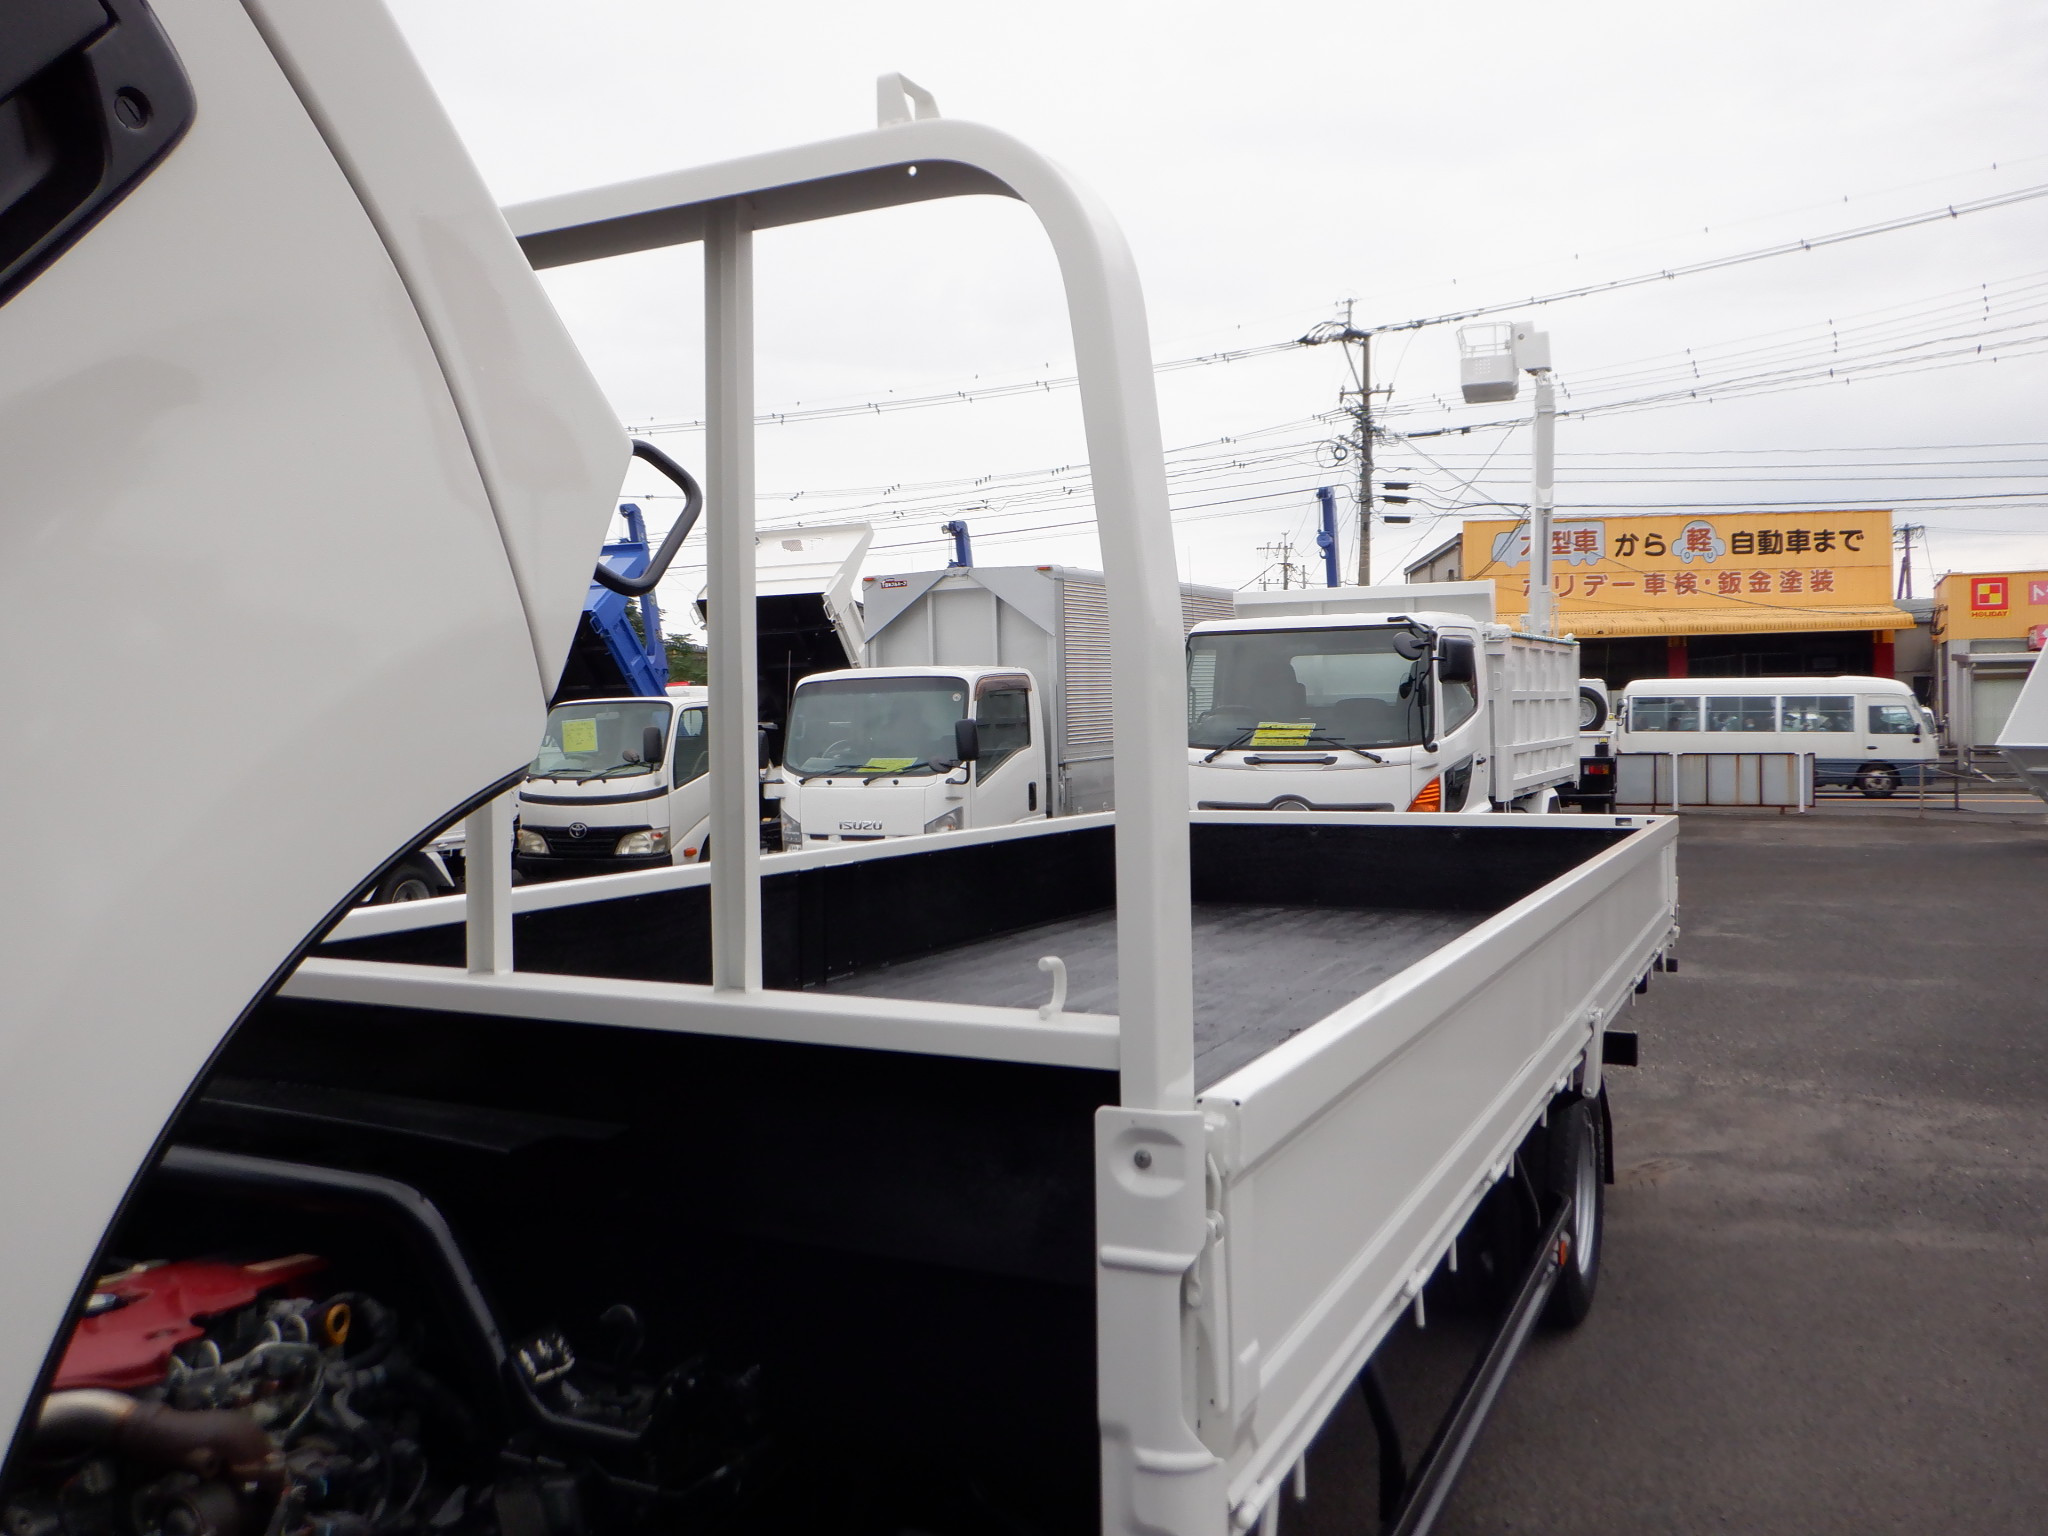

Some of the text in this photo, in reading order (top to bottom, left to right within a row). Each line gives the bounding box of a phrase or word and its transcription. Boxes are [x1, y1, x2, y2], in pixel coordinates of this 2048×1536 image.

[1615, 533, 1667, 557] から
[1686, 527, 1712, 553] 軽
[1731, 529, 1865, 556] 自動車まで
[838, 820, 883, 831] ISUZU
